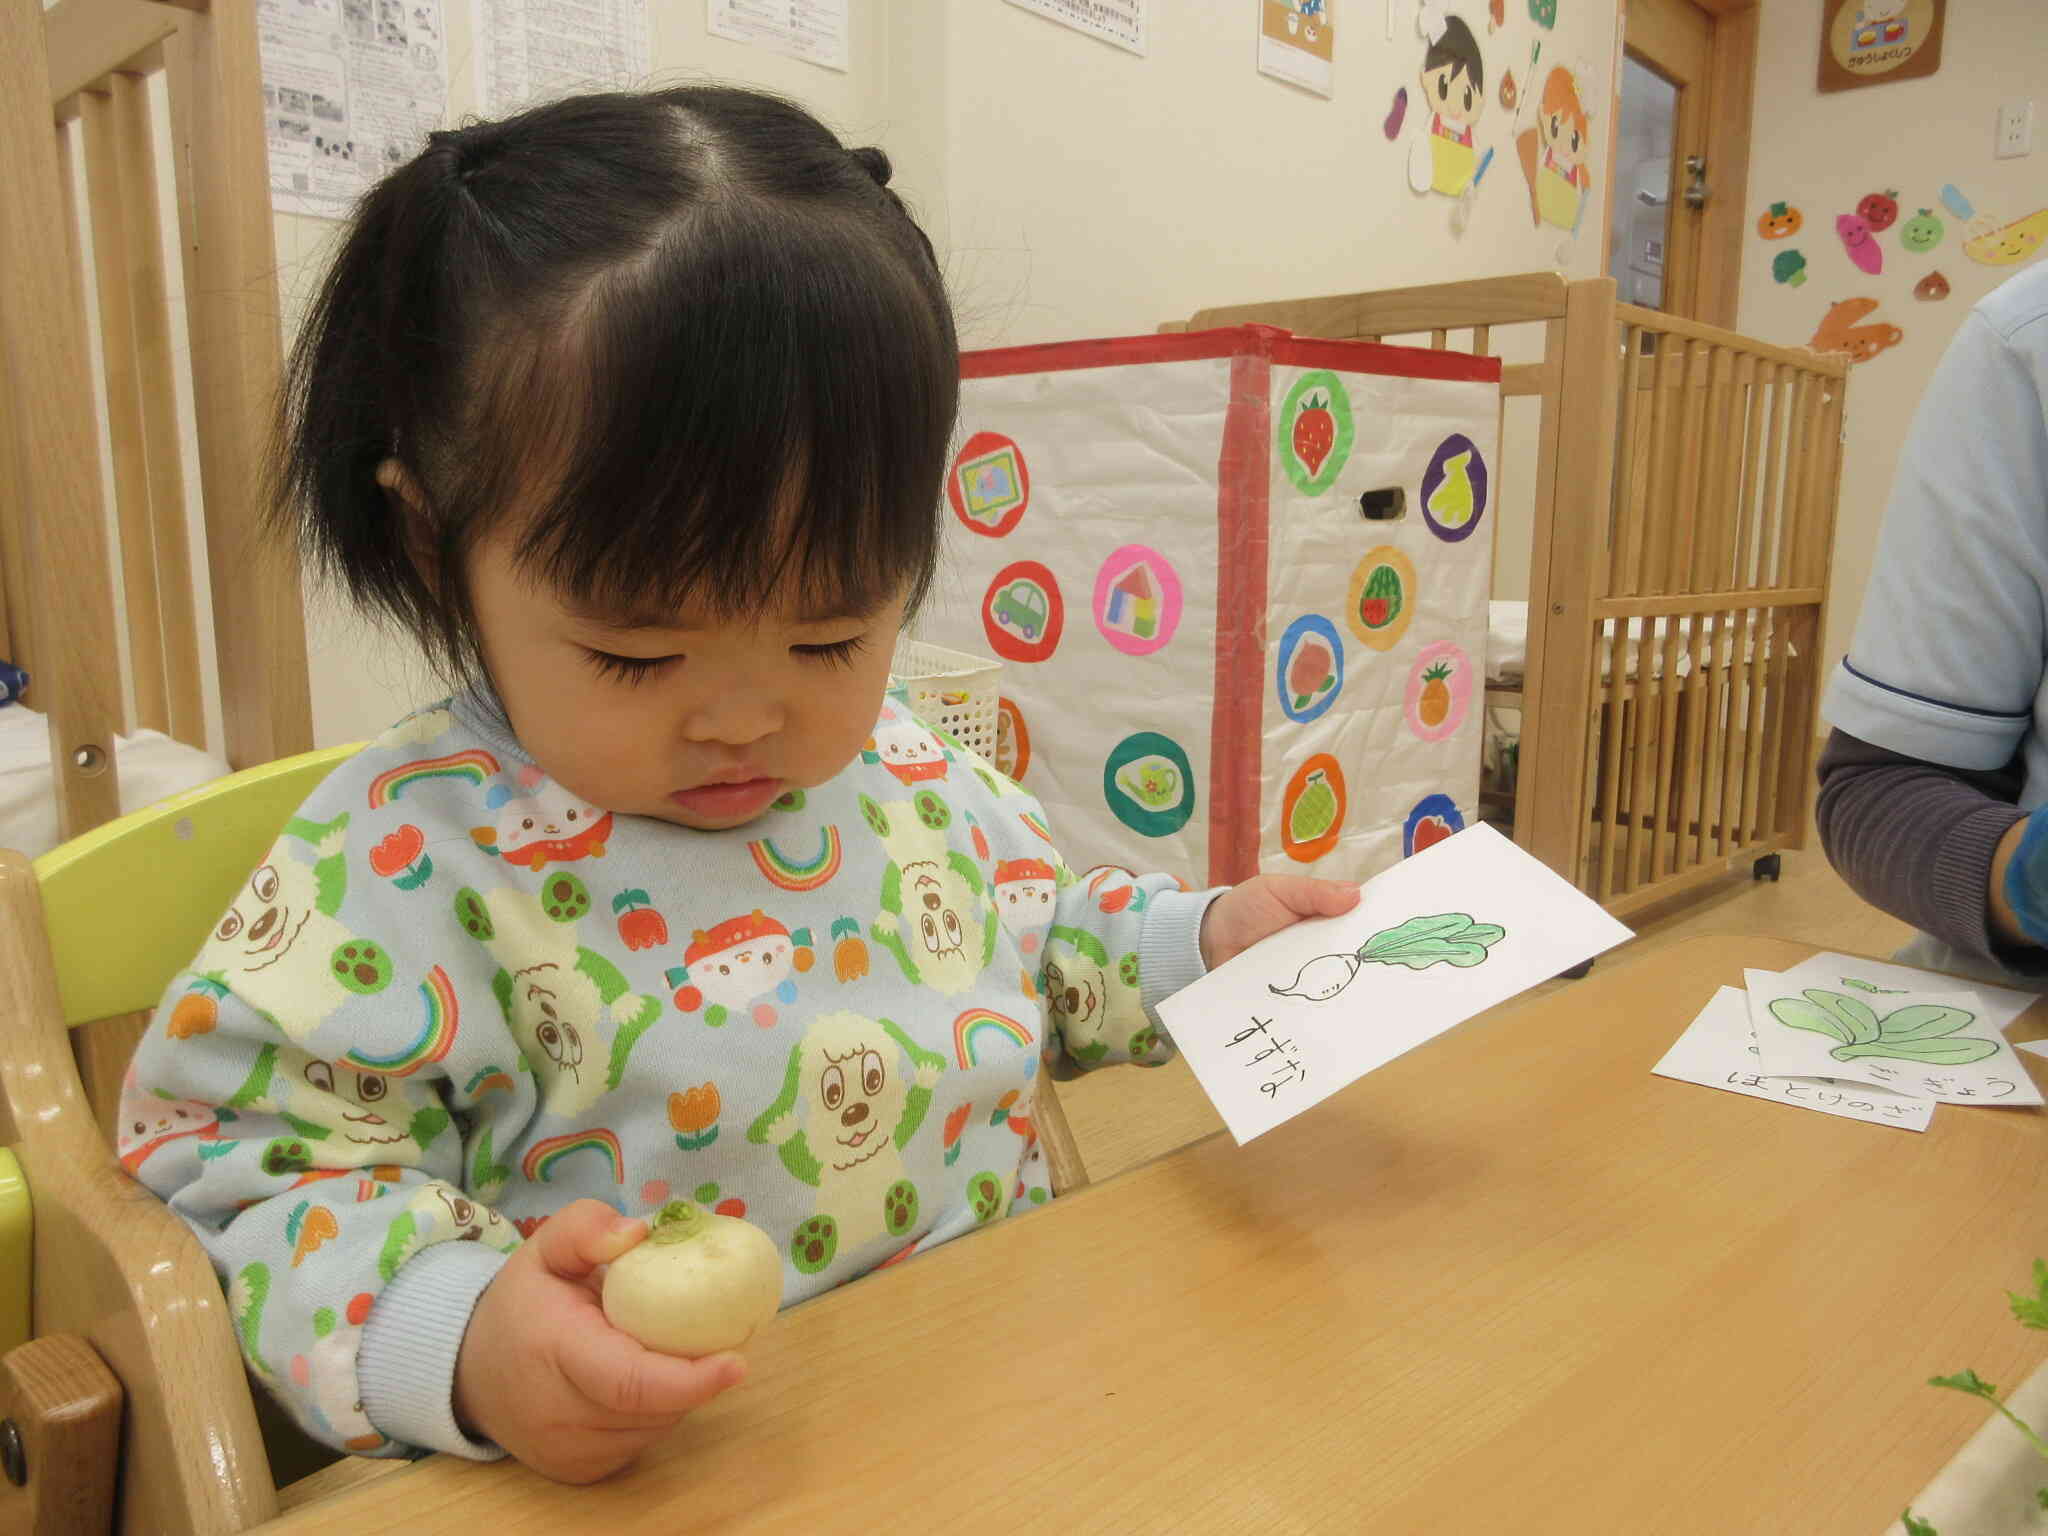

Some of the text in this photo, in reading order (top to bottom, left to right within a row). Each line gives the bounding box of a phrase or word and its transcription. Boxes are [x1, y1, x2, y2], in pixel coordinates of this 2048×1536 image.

[1224, 1016, 1305, 1099] すずな
[1868, 1064, 2016, 1098] ごぎょう
[1727, 1071, 1923, 1119] ほとけのざ
